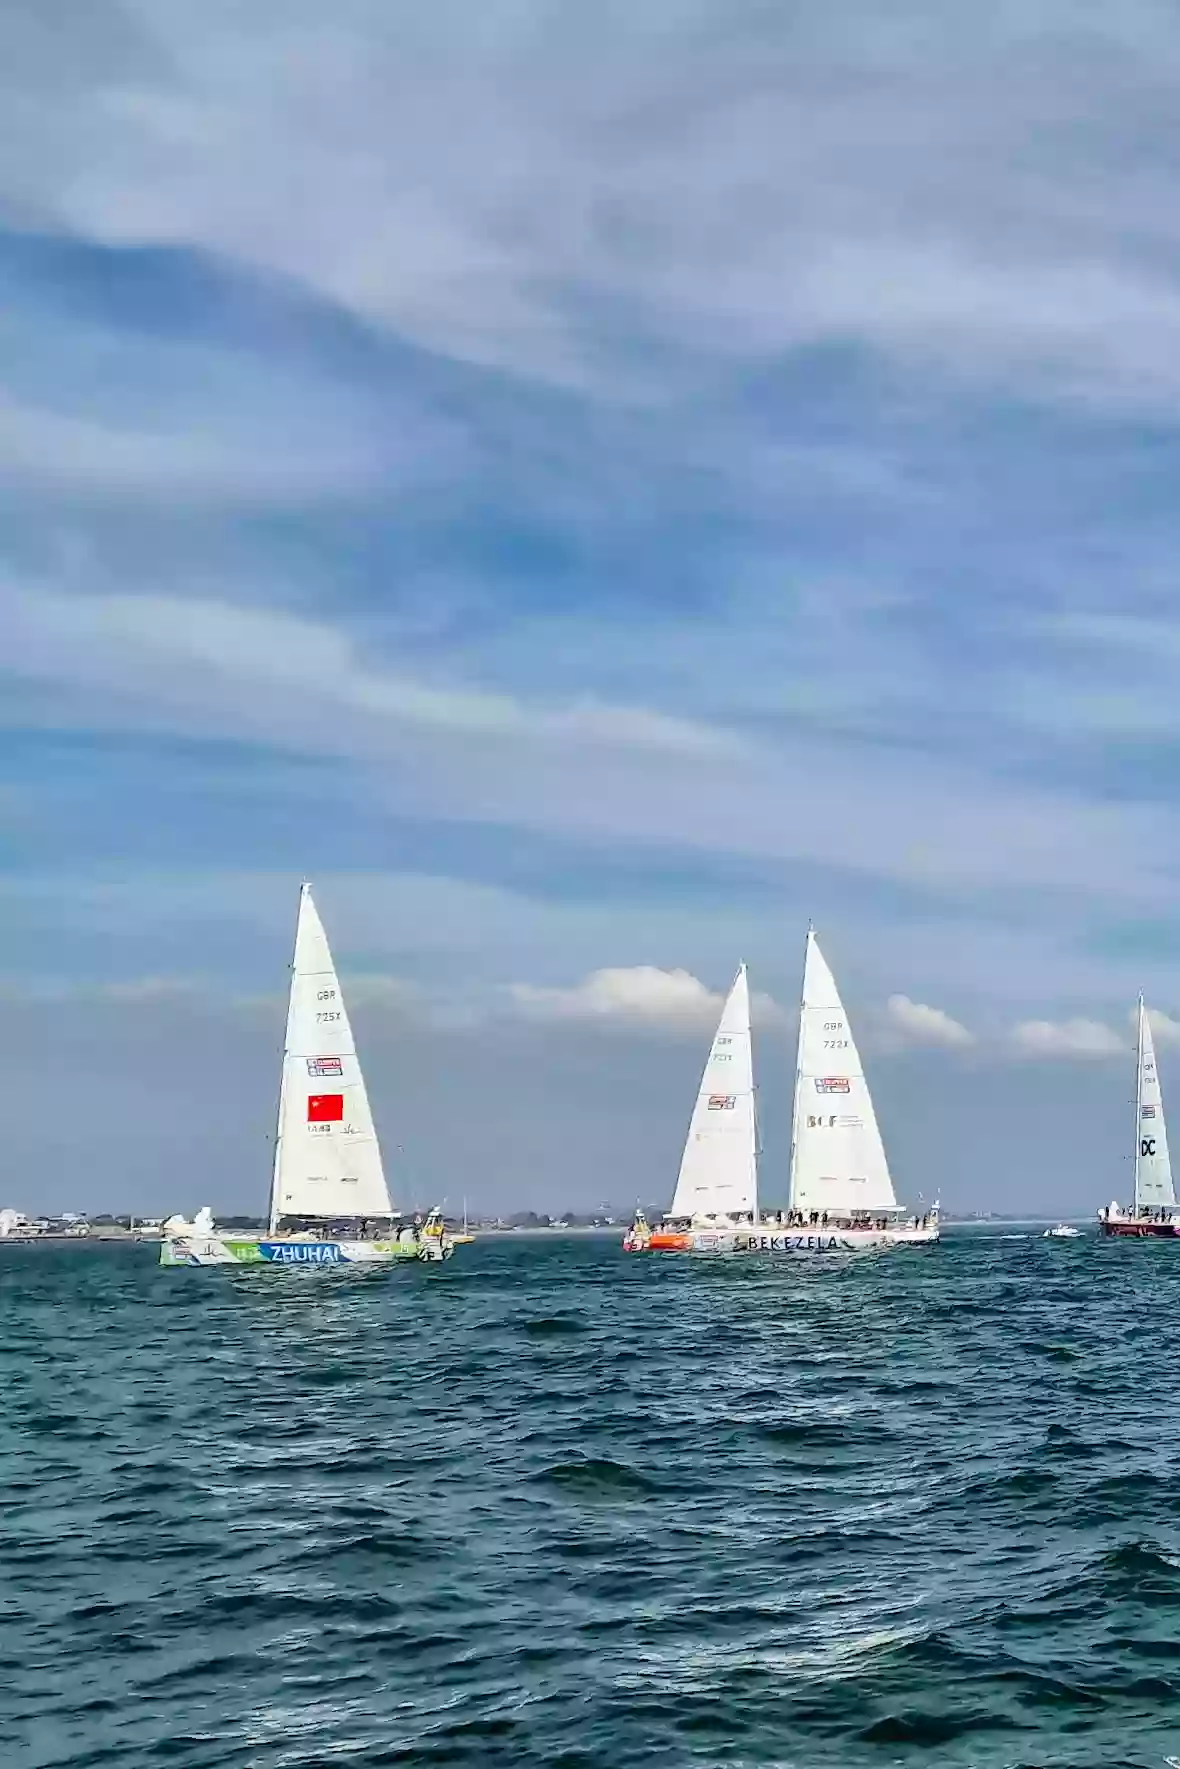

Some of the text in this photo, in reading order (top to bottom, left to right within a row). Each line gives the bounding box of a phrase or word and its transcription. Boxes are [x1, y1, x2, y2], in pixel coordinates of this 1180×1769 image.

[316, 990, 336, 1001] GBR
[1142, 1139, 1156, 1157] DC
[748, 1235, 838, 1250] BEKEZELA
[270, 1245, 339, 1262] ZHUHAI
